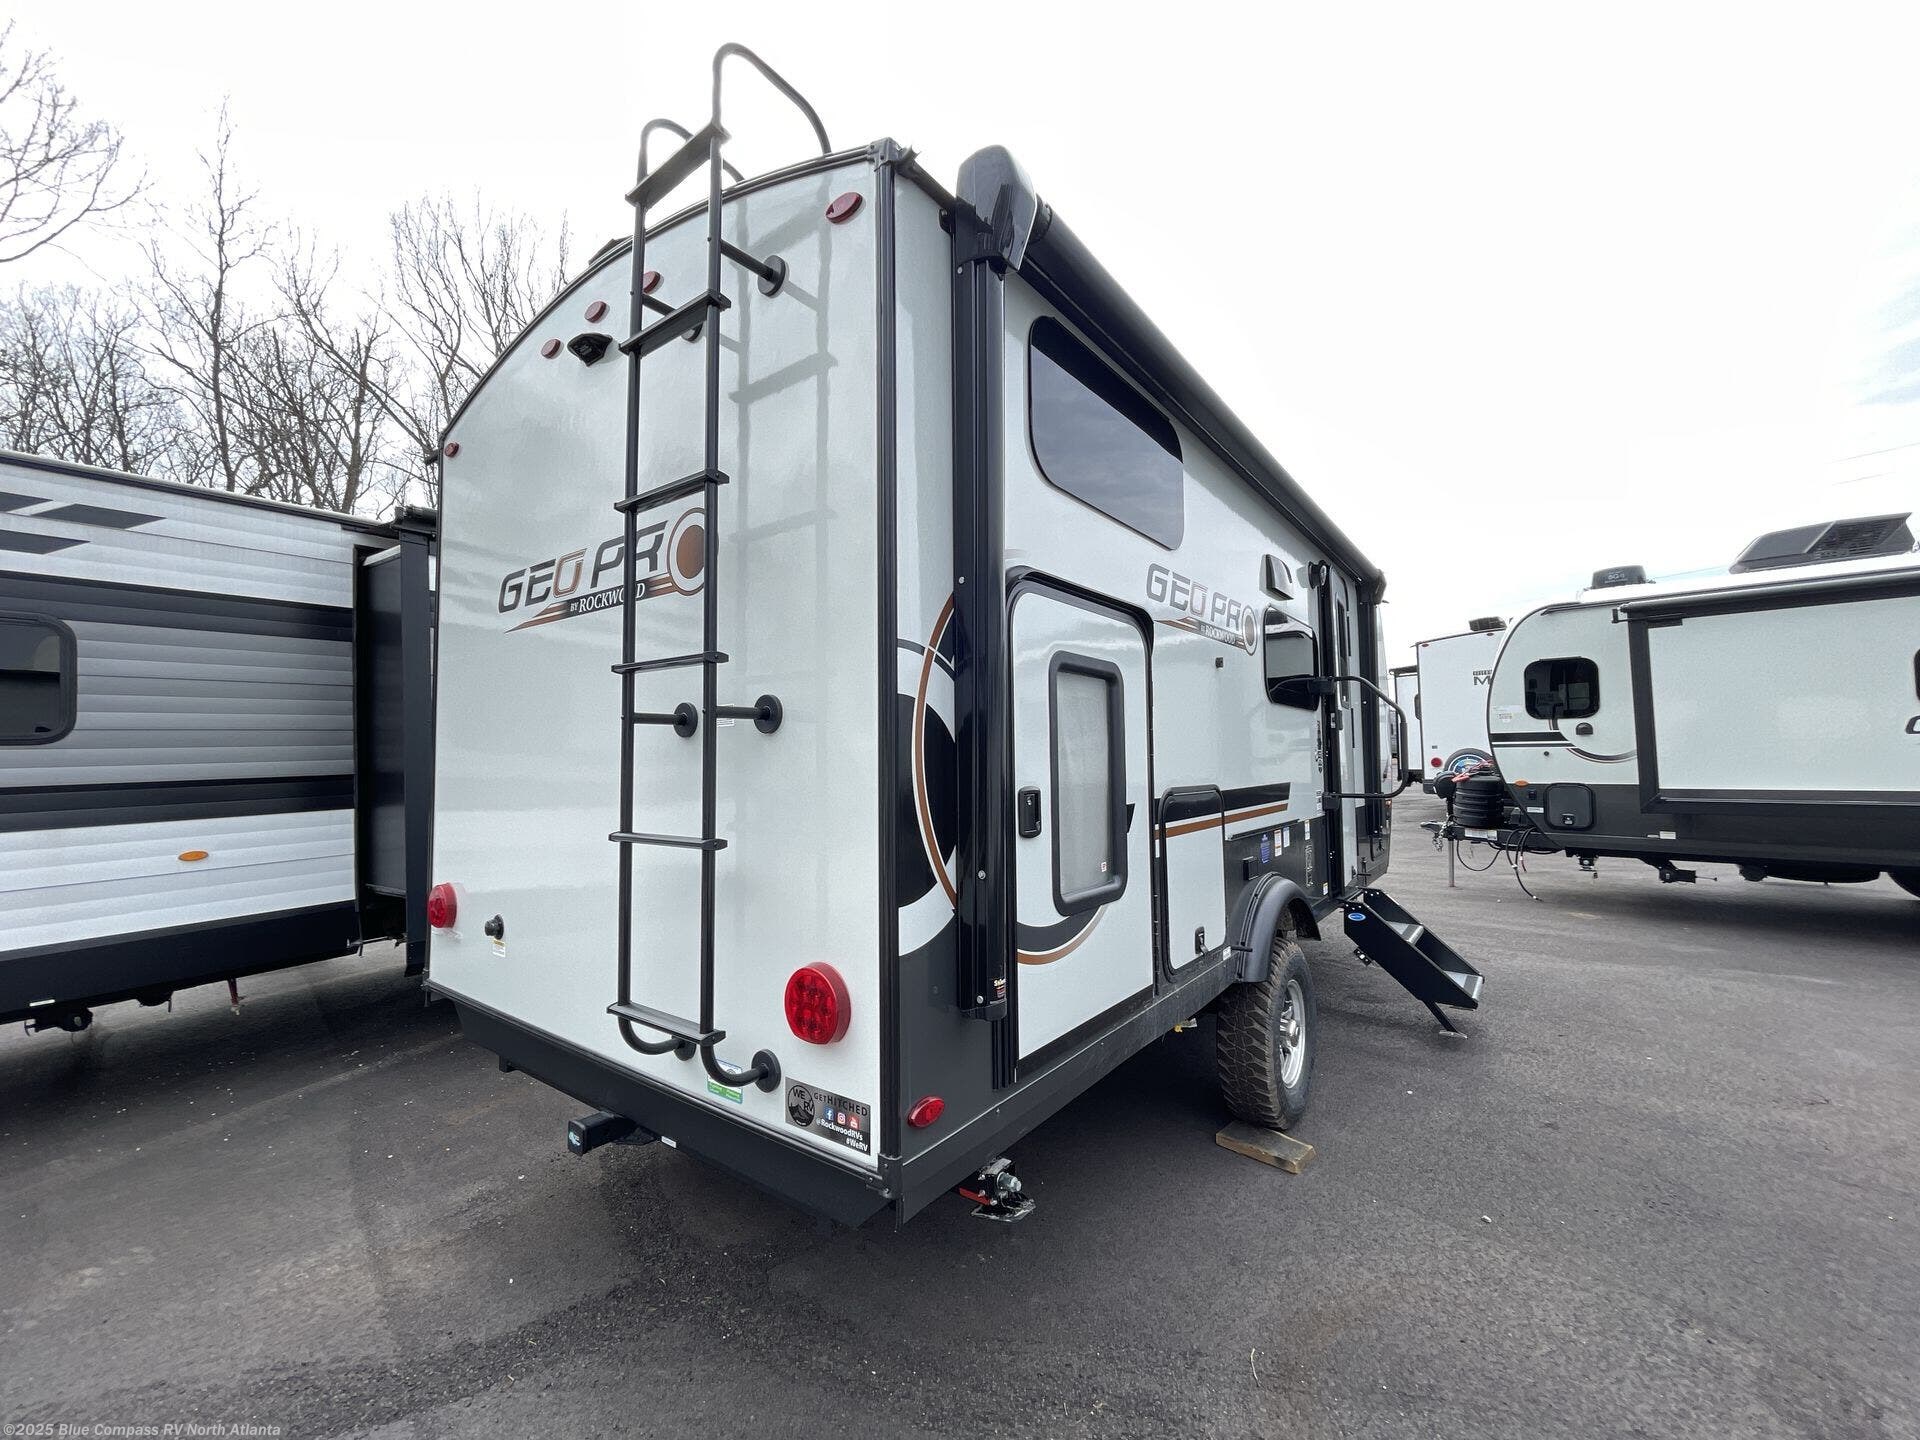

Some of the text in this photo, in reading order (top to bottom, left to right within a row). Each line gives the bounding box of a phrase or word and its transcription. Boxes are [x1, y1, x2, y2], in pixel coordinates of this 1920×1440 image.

[498, 507, 719, 613] GEO PRO
[1146, 562, 1209, 618] GEO
[570, 601, 579, 612] BY
[793, 1088, 806, 1099] WE
[803, 1100, 814, 1115] RV
[815, 1117, 863, 1141] @RockwoodRVs
